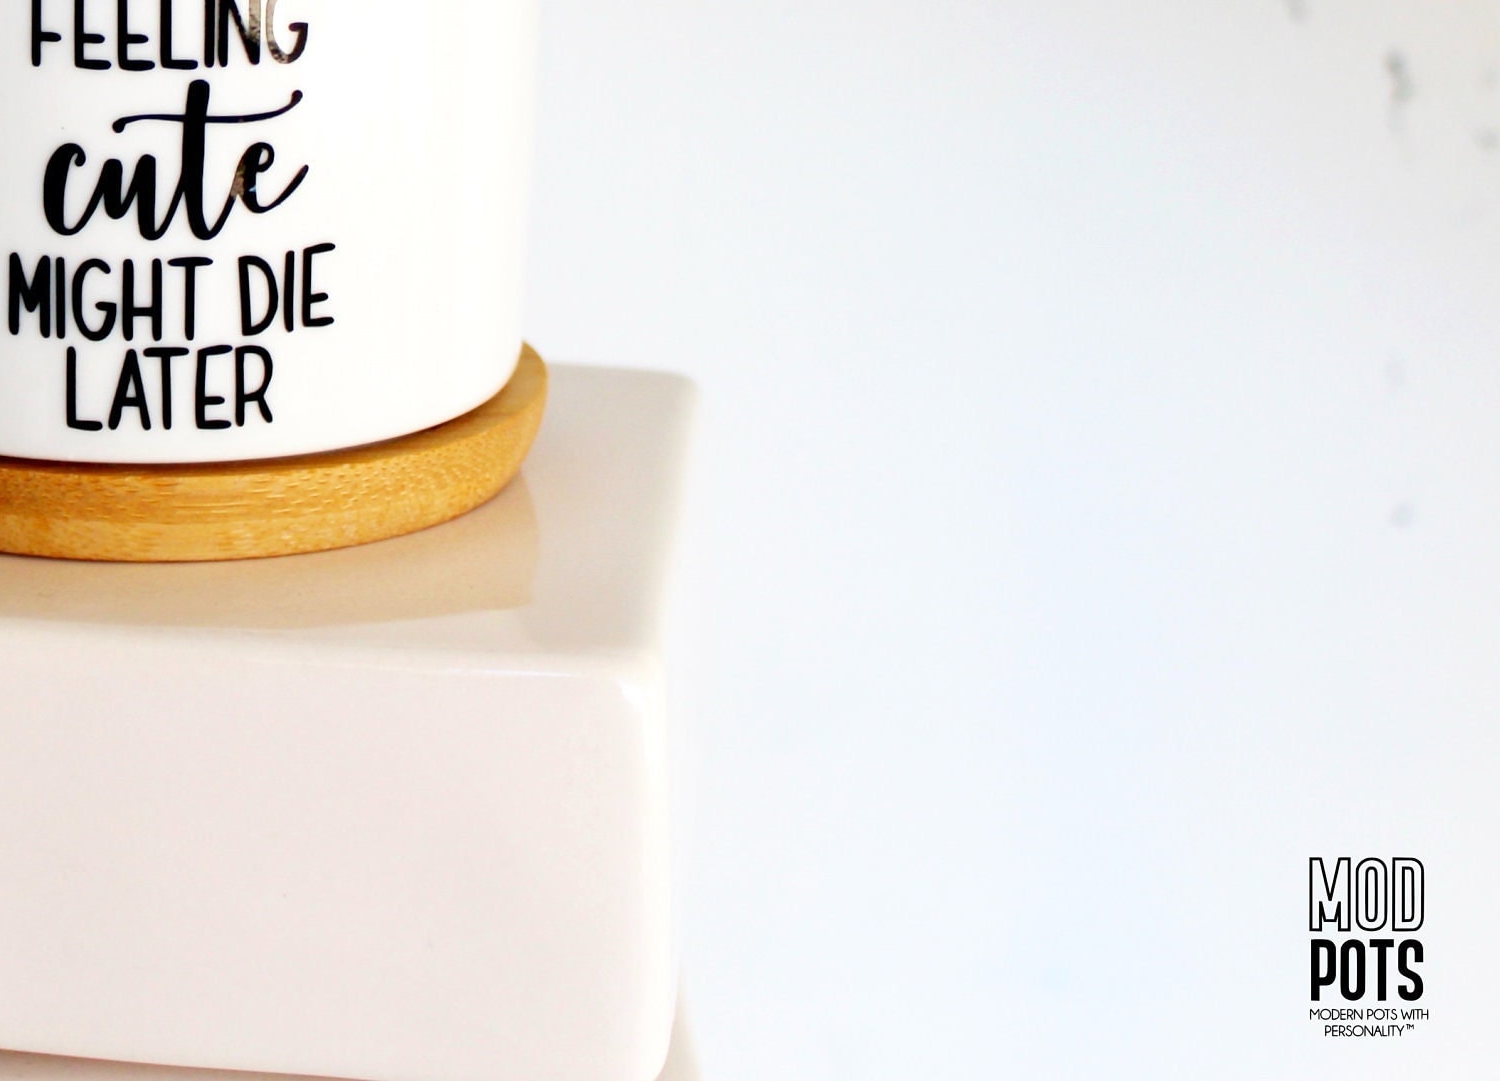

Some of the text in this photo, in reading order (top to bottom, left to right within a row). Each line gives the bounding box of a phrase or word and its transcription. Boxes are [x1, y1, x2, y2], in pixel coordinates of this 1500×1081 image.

[42, 79, 309, 241] cute
[7, 242, 337, 342] MIGHT DIE
[65, 344, 274, 432] LATER
